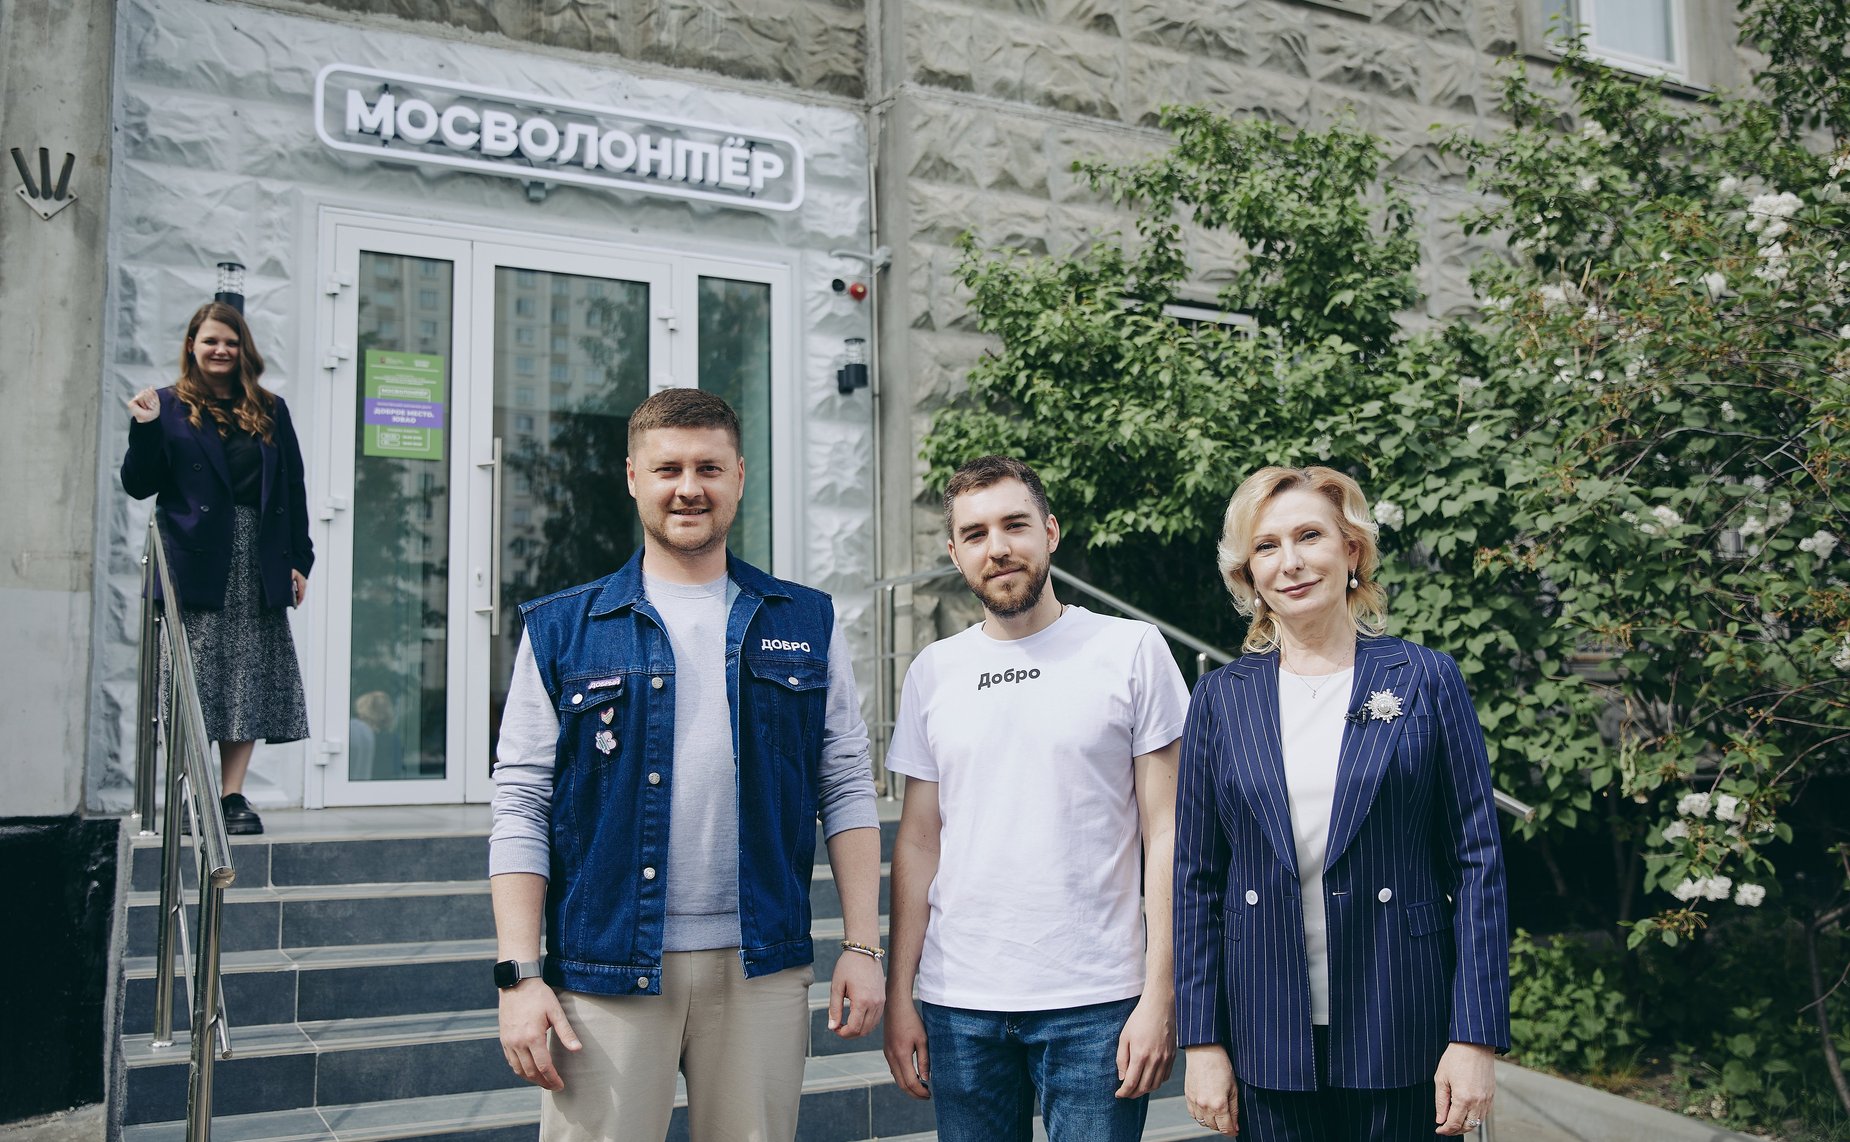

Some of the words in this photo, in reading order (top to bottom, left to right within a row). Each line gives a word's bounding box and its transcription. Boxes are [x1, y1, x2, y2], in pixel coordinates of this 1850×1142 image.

[346, 89, 784, 193] МОСВОЛОНТЁР
[761, 638, 811, 653] ДОБРО
[977, 668, 1041, 691] Добро
